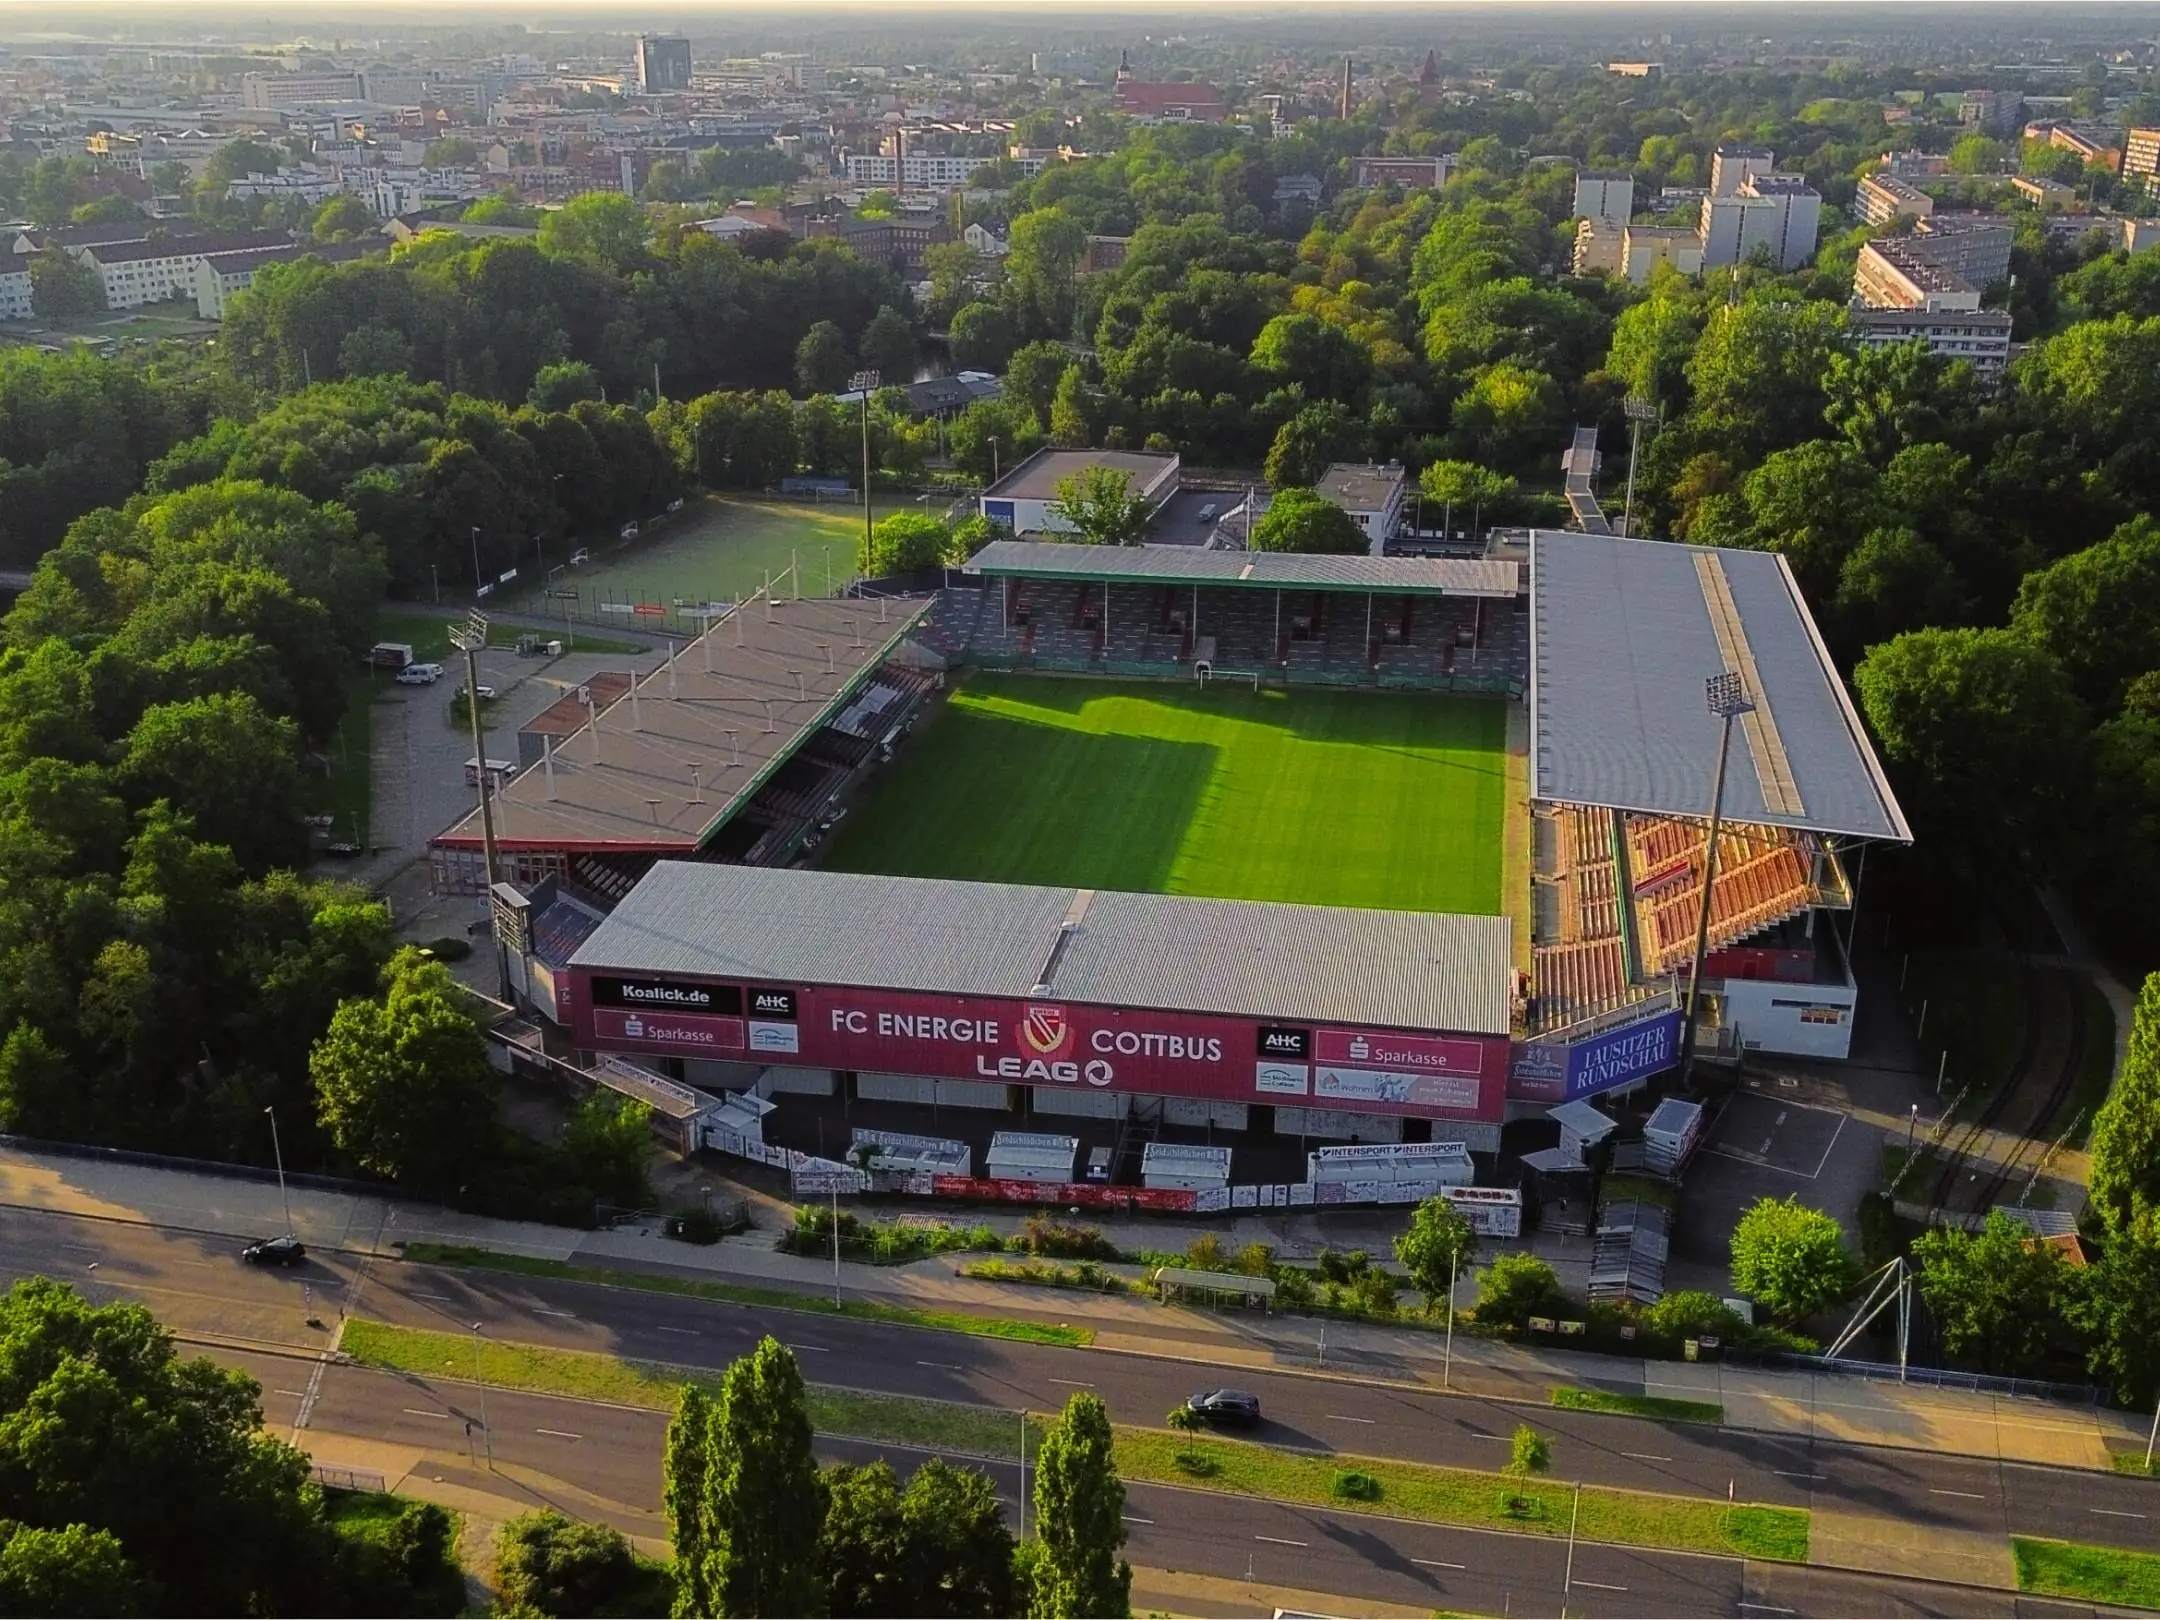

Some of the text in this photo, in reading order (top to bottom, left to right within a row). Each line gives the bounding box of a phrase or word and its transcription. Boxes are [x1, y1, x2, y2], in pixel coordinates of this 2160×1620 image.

[623, 985, 710, 1003] Koalick.de
[756, 995, 789, 1008] AHC
[648, 1026, 713, 1043] Sparkasse
[831, 1009, 1222, 1062] FC ENERGIE COTTBUS
[1265, 1034, 1300, 1047] AHC
[1584, 1026, 1666, 1069] LAUSITZER
[1375, 1048, 1447, 1066] Sparkasse
[1576, 1042, 1670, 1089] RUNDSCHAU
[1331, 1143, 1463, 1157] INTERSPORT INTERSPORT
